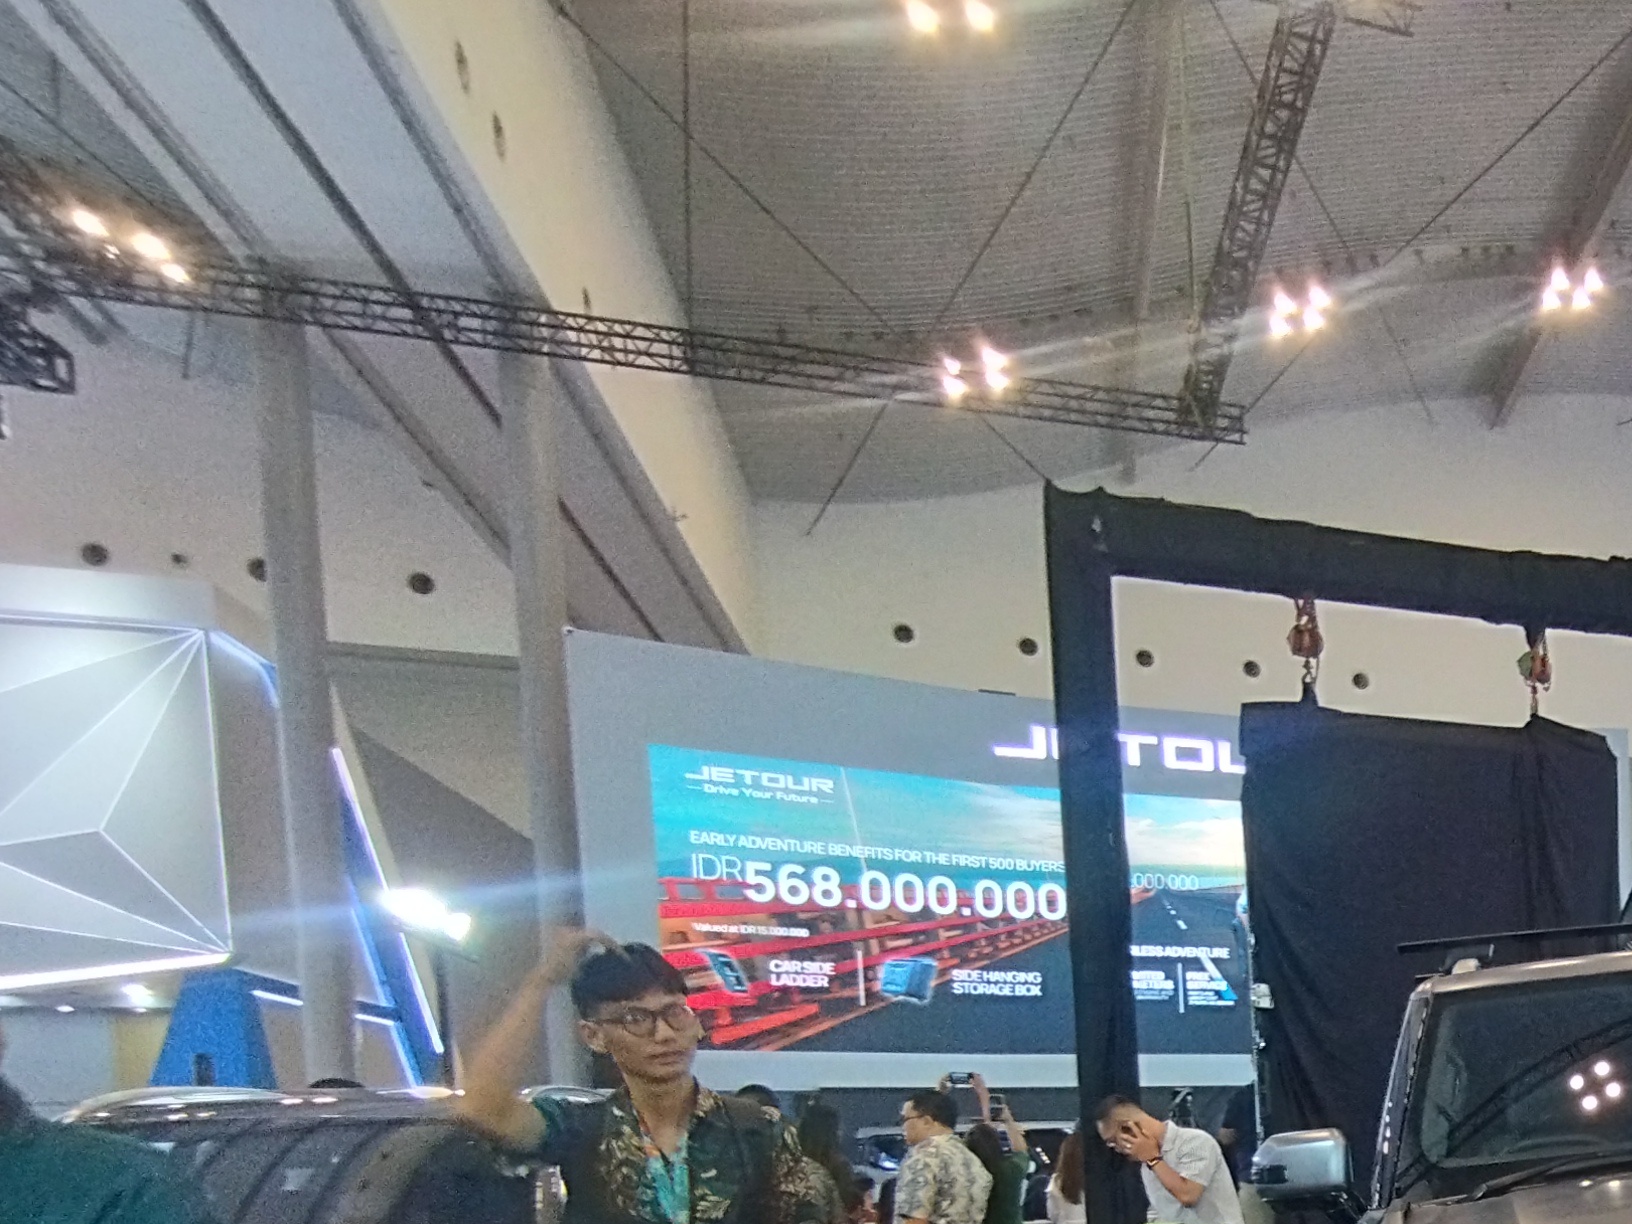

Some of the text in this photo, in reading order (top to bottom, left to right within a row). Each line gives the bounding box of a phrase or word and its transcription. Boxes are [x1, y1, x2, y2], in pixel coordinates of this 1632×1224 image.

[685, 765, 834, 793] JETOUR
[703, 783, 818, 804] Drive Your Future
[690, 830, 1066, 873] EARLY ADVENTURE BENEFITS FOR THE FIRST 500 BUYERS
[769, 959, 836, 975] CAR SIDE
[770, 973, 829, 987] LADDER
[951, 969, 1042, 984] SIDE HANGING
[952, 982, 1042, 996] STORAGE BOX
